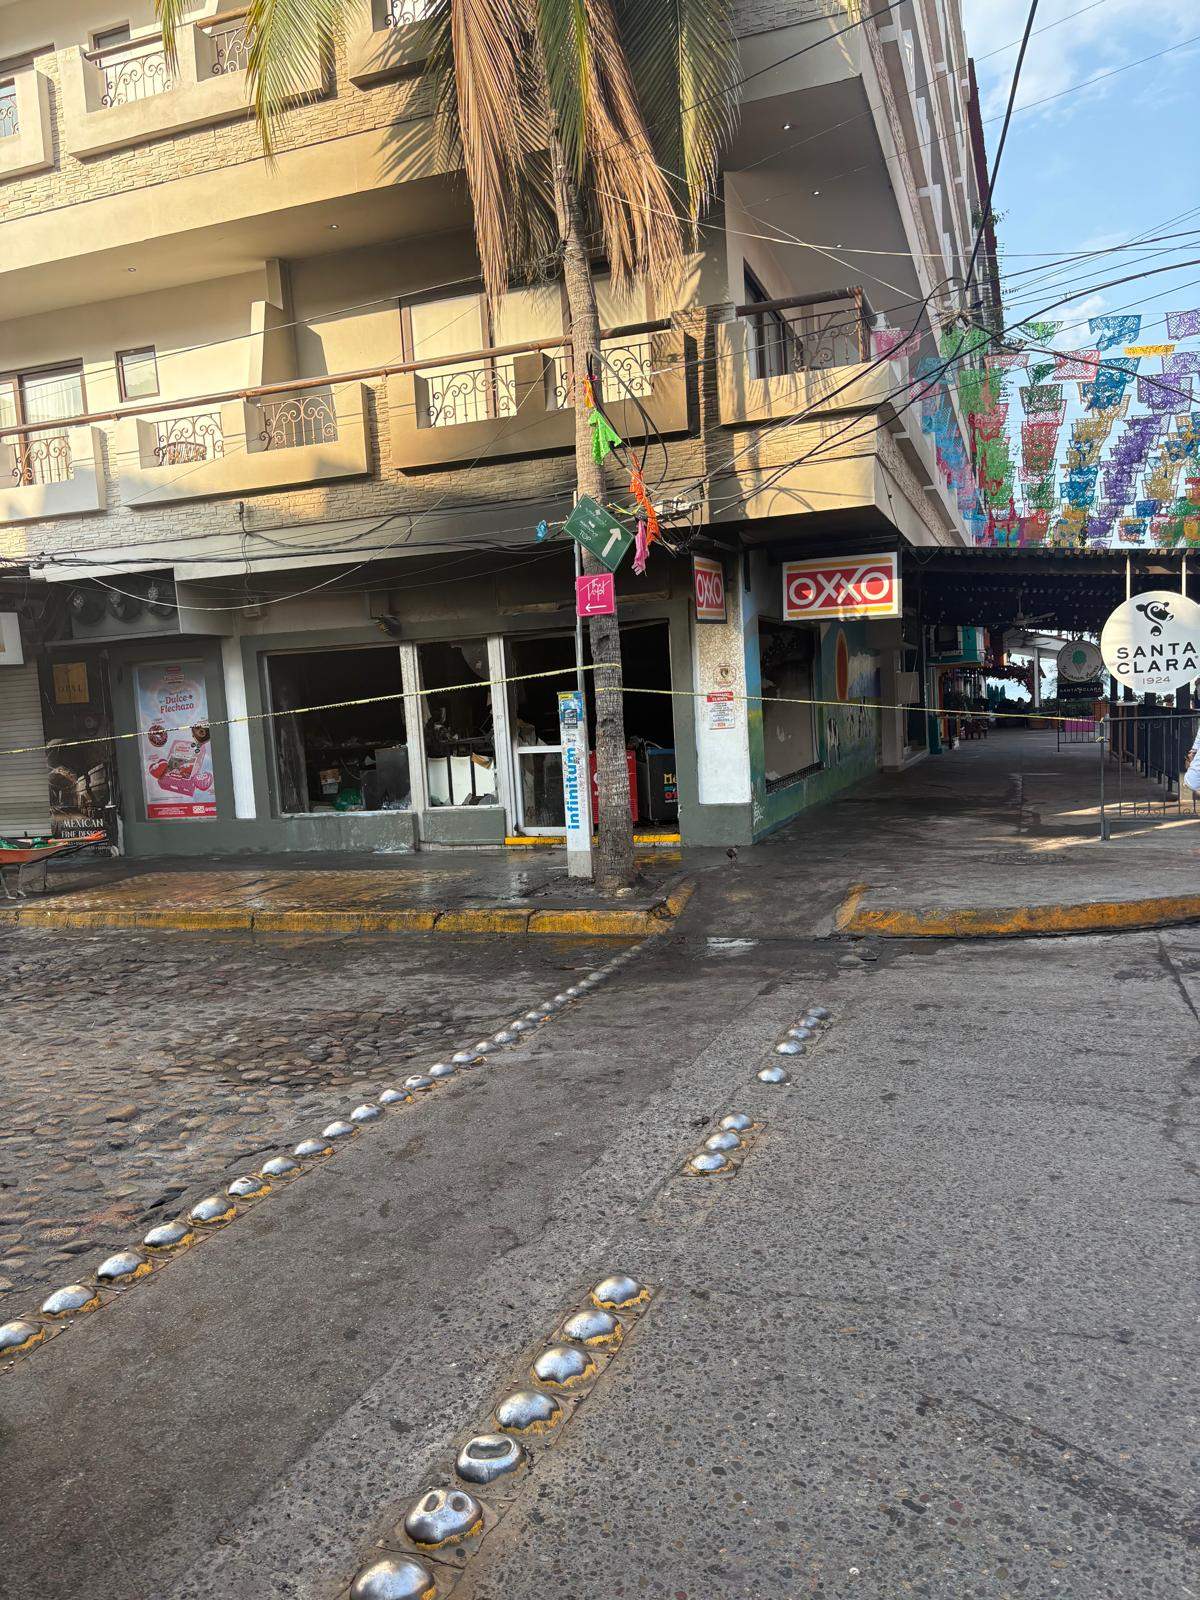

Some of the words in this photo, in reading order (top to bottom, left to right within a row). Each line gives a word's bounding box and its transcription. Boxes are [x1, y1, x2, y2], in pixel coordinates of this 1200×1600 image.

[696, 573, 722, 607] OXXO
[789, 566, 889, 608] OXXO
[1117, 642, 1196, 659] SANTA
[1117, 658, 1196, 674] CLARA
[1142, 676, 1170, 684] 1924
[165, 694, 187, 705] Dulce
[160, 703, 194, 714] Flechazo
[565, 747, 580, 829] infinitum
[63, 818, 104, 828] MEXICAN
[61, 830, 76, 838] FINE
